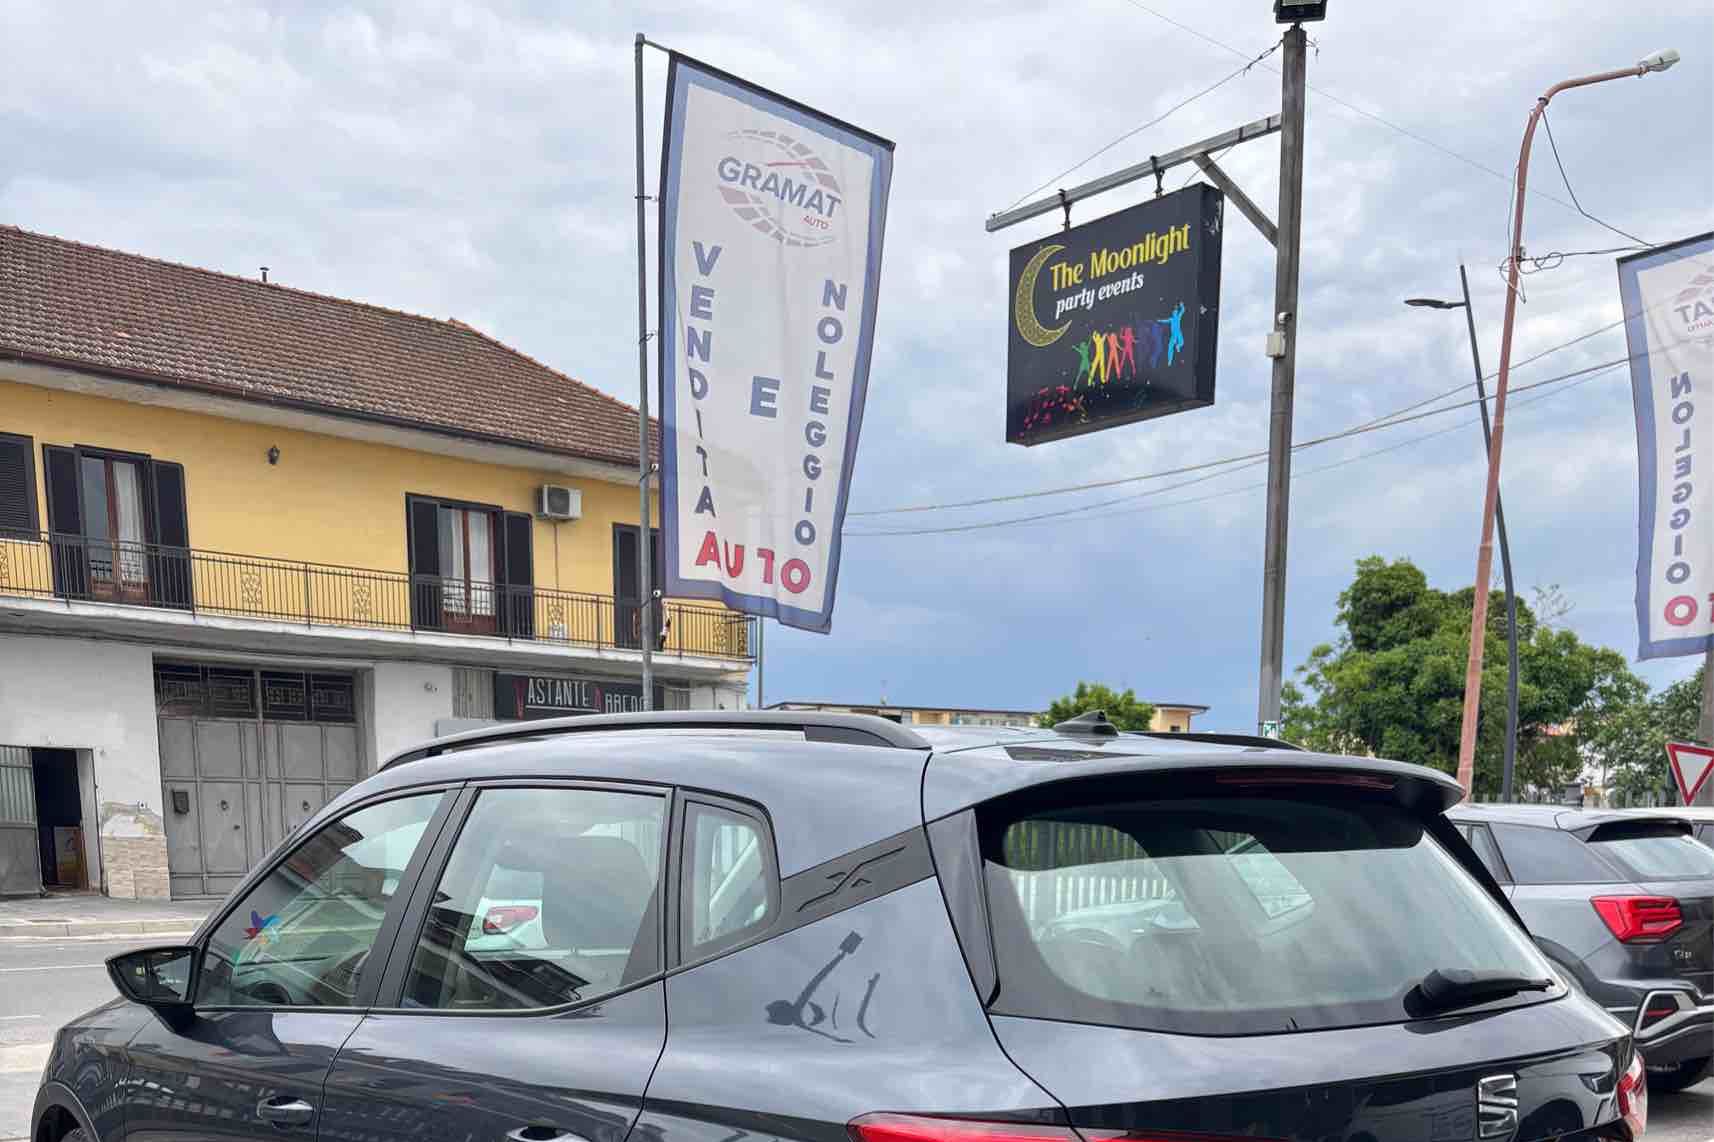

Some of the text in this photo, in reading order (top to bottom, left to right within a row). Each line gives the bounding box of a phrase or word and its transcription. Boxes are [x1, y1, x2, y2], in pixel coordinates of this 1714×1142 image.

[717, 156, 842, 218] GRAMAT
[803, 214, 829, 230] AUTO
[1050, 223, 1192, 291] The Moonlight
[1055, 271, 1145, 320] party events
[687, 240, 722, 518] VENDITA
[750, 375, 780, 419] E
[794, 279, 847, 546] NOLEGGIO
[694, 530, 811, 594] AUTO
